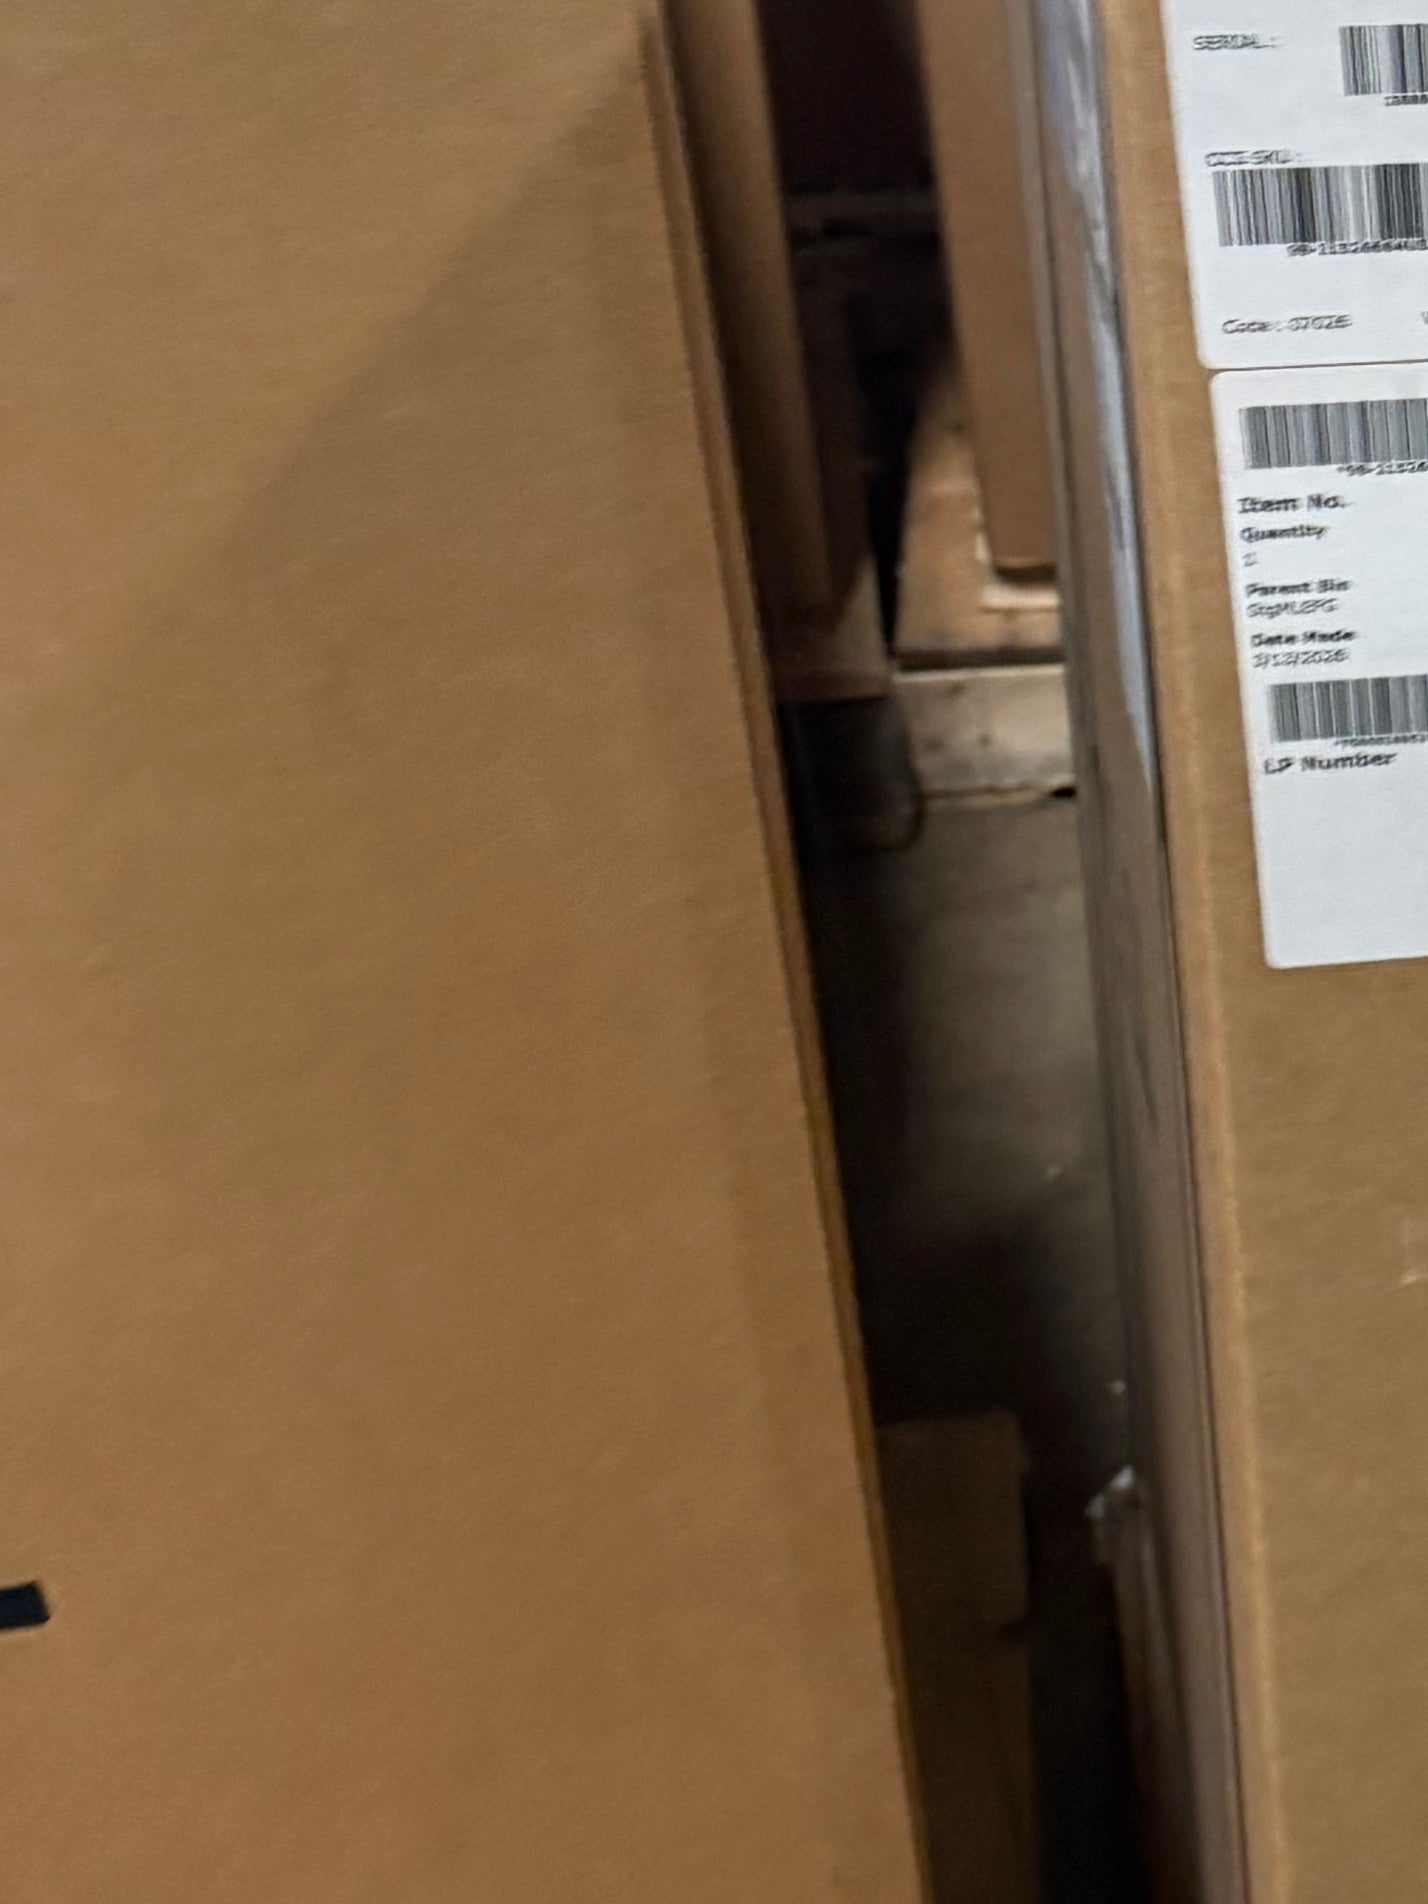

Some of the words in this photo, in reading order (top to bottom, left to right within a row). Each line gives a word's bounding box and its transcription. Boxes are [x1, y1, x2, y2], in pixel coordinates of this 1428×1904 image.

[1238, 495, 1299, 512] Item
[1240, 524, 1328, 546] Quantity
[1250, 633, 1297, 648] Date
[1301, 751, 1400, 772] Number
